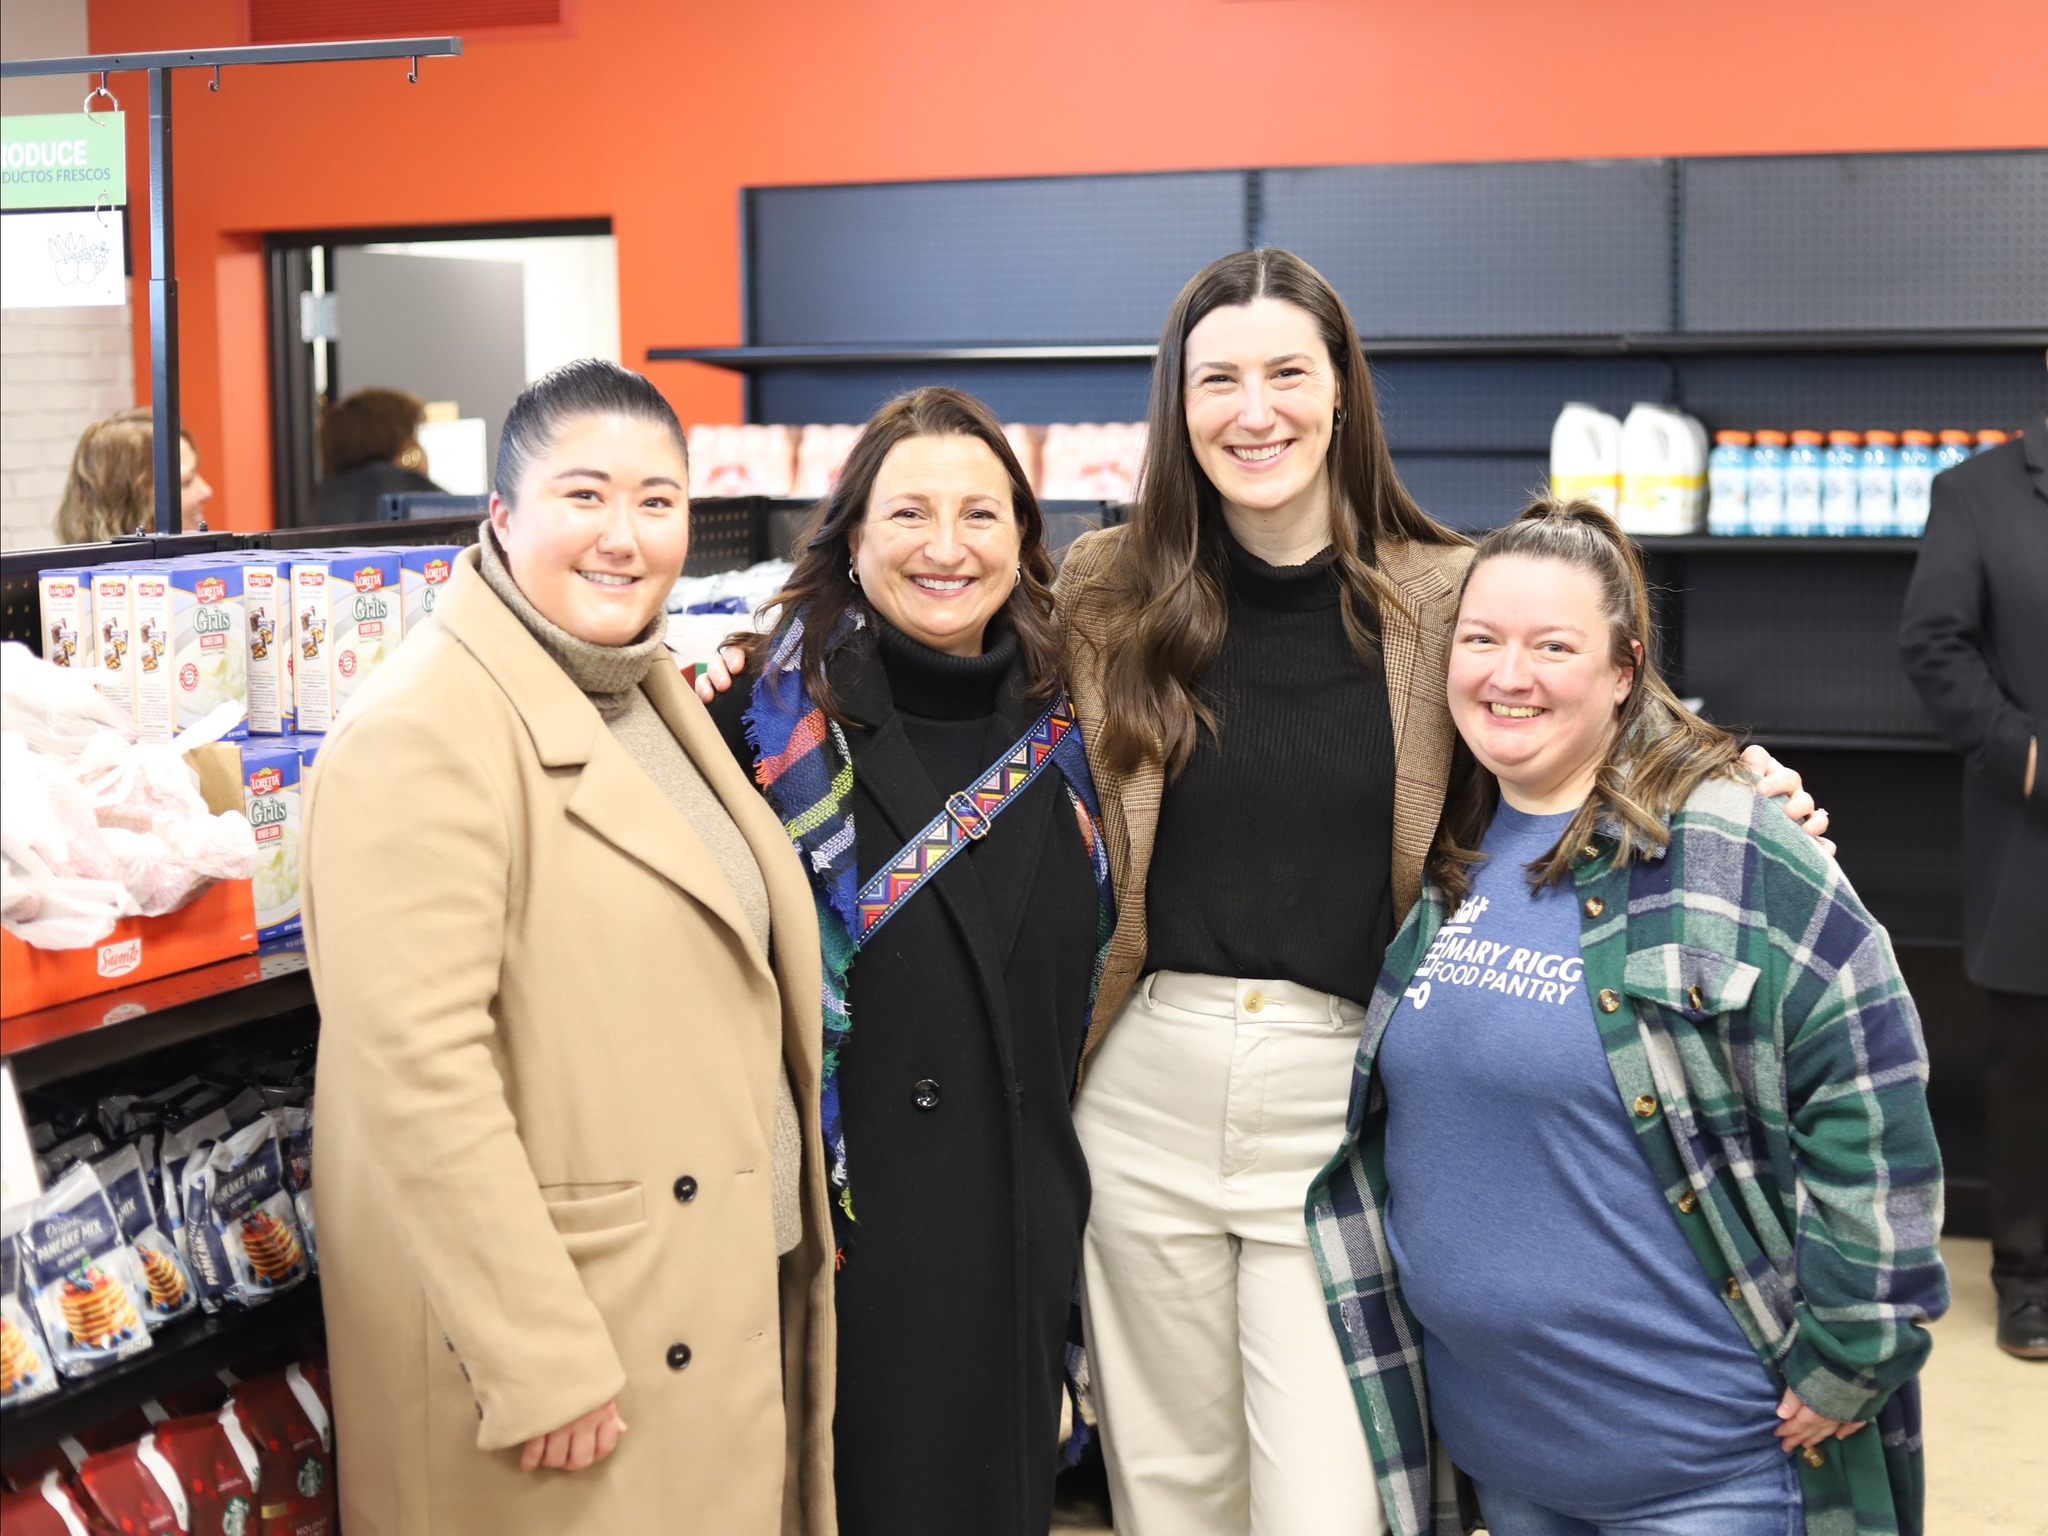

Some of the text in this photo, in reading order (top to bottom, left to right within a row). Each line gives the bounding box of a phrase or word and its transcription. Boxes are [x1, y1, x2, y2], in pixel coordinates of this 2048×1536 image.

[56, 167, 111, 182] FRESCOS
[356, 574, 383, 589] LORETTA
[425, 565, 449, 580] LORETTA
[197, 584, 224, 598] LORETTA
[352, 595, 387, 621] Grits
[194, 606, 230, 633] Grits
[251, 773, 280, 789] LORETTA
[249, 797, 286, 826] Grits
[1441, 937, 1584, 983] MARY RIGG
[1429, 961, 1576, 1006] FOOD PANTRY
[247, 1165, 268, 1185] MIX
[119, 1198, 136, 1218] MIX
[37, 1220, 103, 1264] PANCAKE MIX
